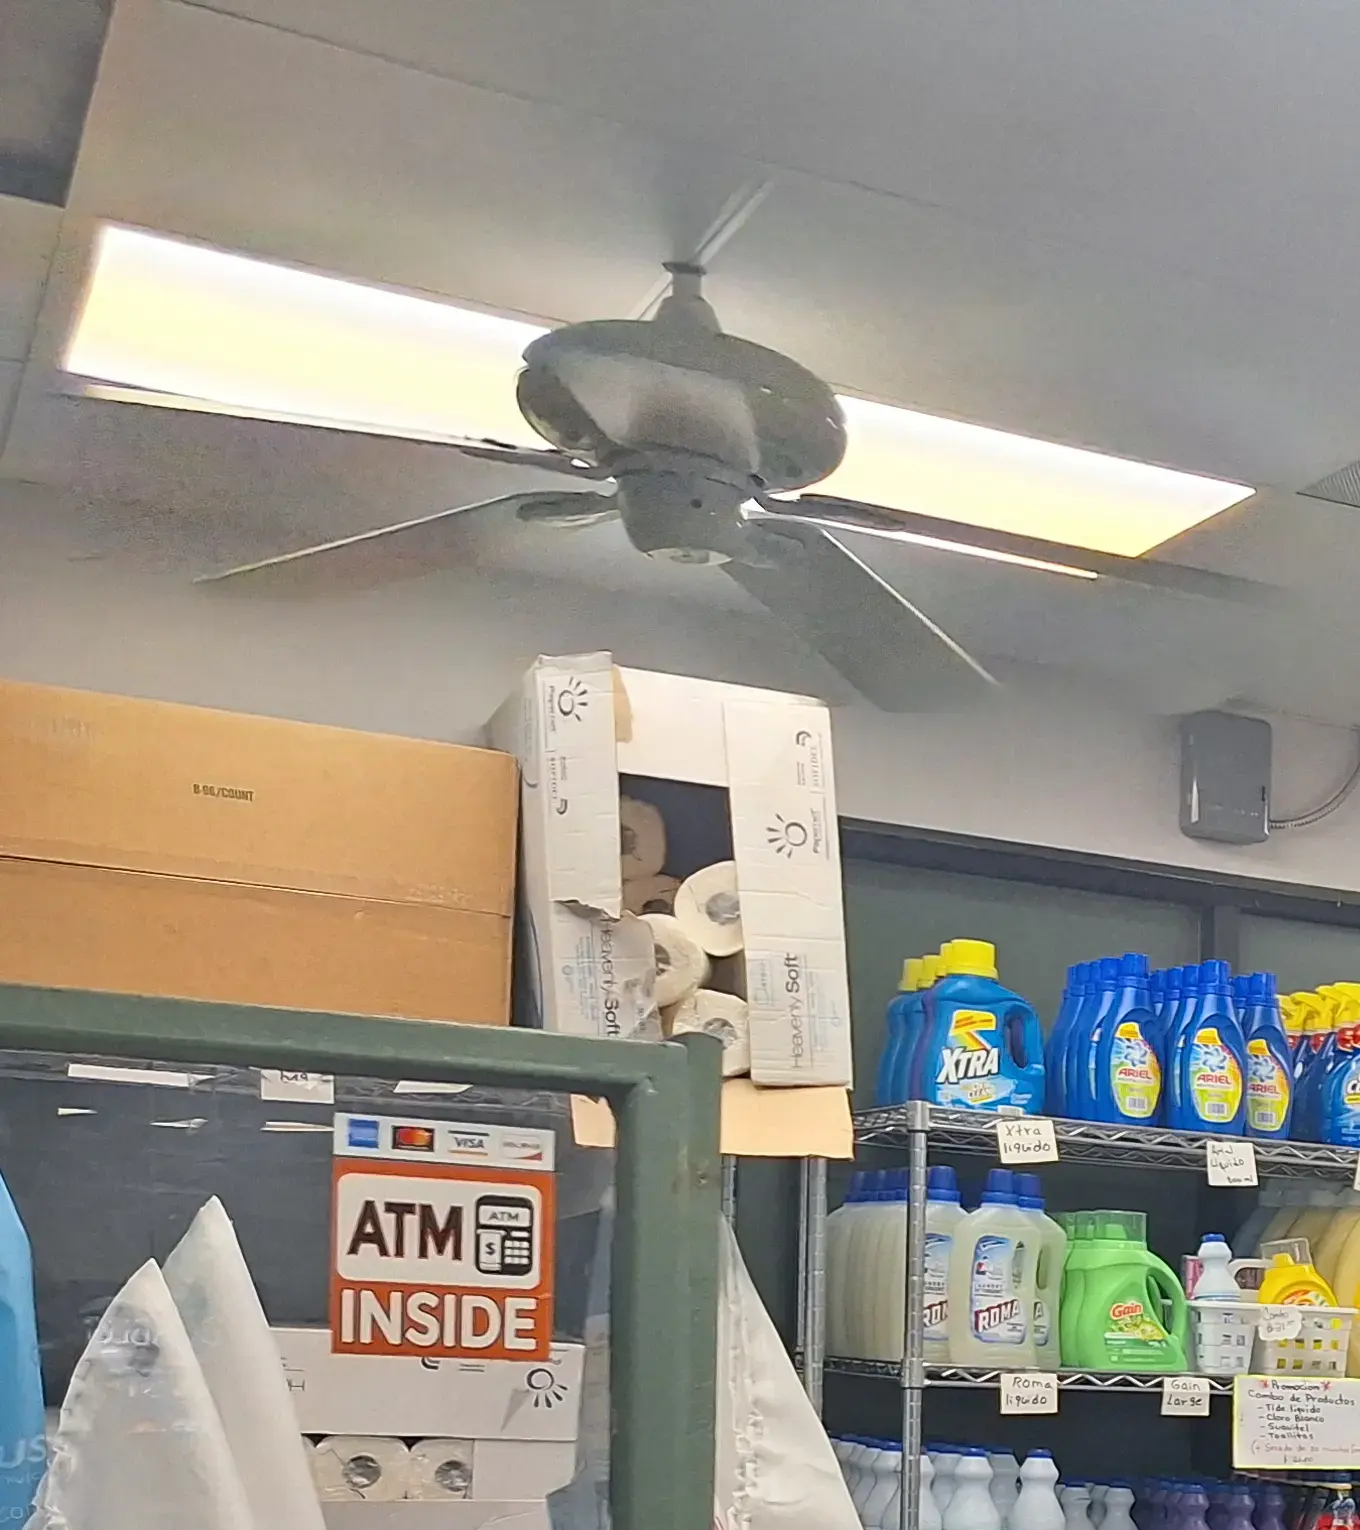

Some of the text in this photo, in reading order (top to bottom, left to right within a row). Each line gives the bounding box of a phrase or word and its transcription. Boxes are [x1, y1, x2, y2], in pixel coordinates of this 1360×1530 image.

[604, 998, 621, 1037] Soft
[784, 952, 807, 1069] Heavenly Soft
[936, 1047, 999, 1084] XTRA
[1118, 1068, 1152, 1080] ARIEL
[1197, 1074, 1232, 1085] ARIEL
[1248, 1083, 1281, 1095] ARIEL
[1005, 1125, 1042, 1136] Xtra
[454, 1137, 485, 1150] VISA
[488, 1211, 521, 1222] ATM
[346, 1200, 464, 1261] ATM
[974, 1299, 1021, 1333] ROMA
[1112, 1303, 1143, 1317] Gain
[340, 1288, 538, 1351] INSIDE
[1013, 1376, 1053, 1390] Roma
[1171, 1379, 1201, 1391] Gain
[1248, 1389, 1355, 1406] Combo de Productos
[1265, 1403, 1286, 1412] Tide
